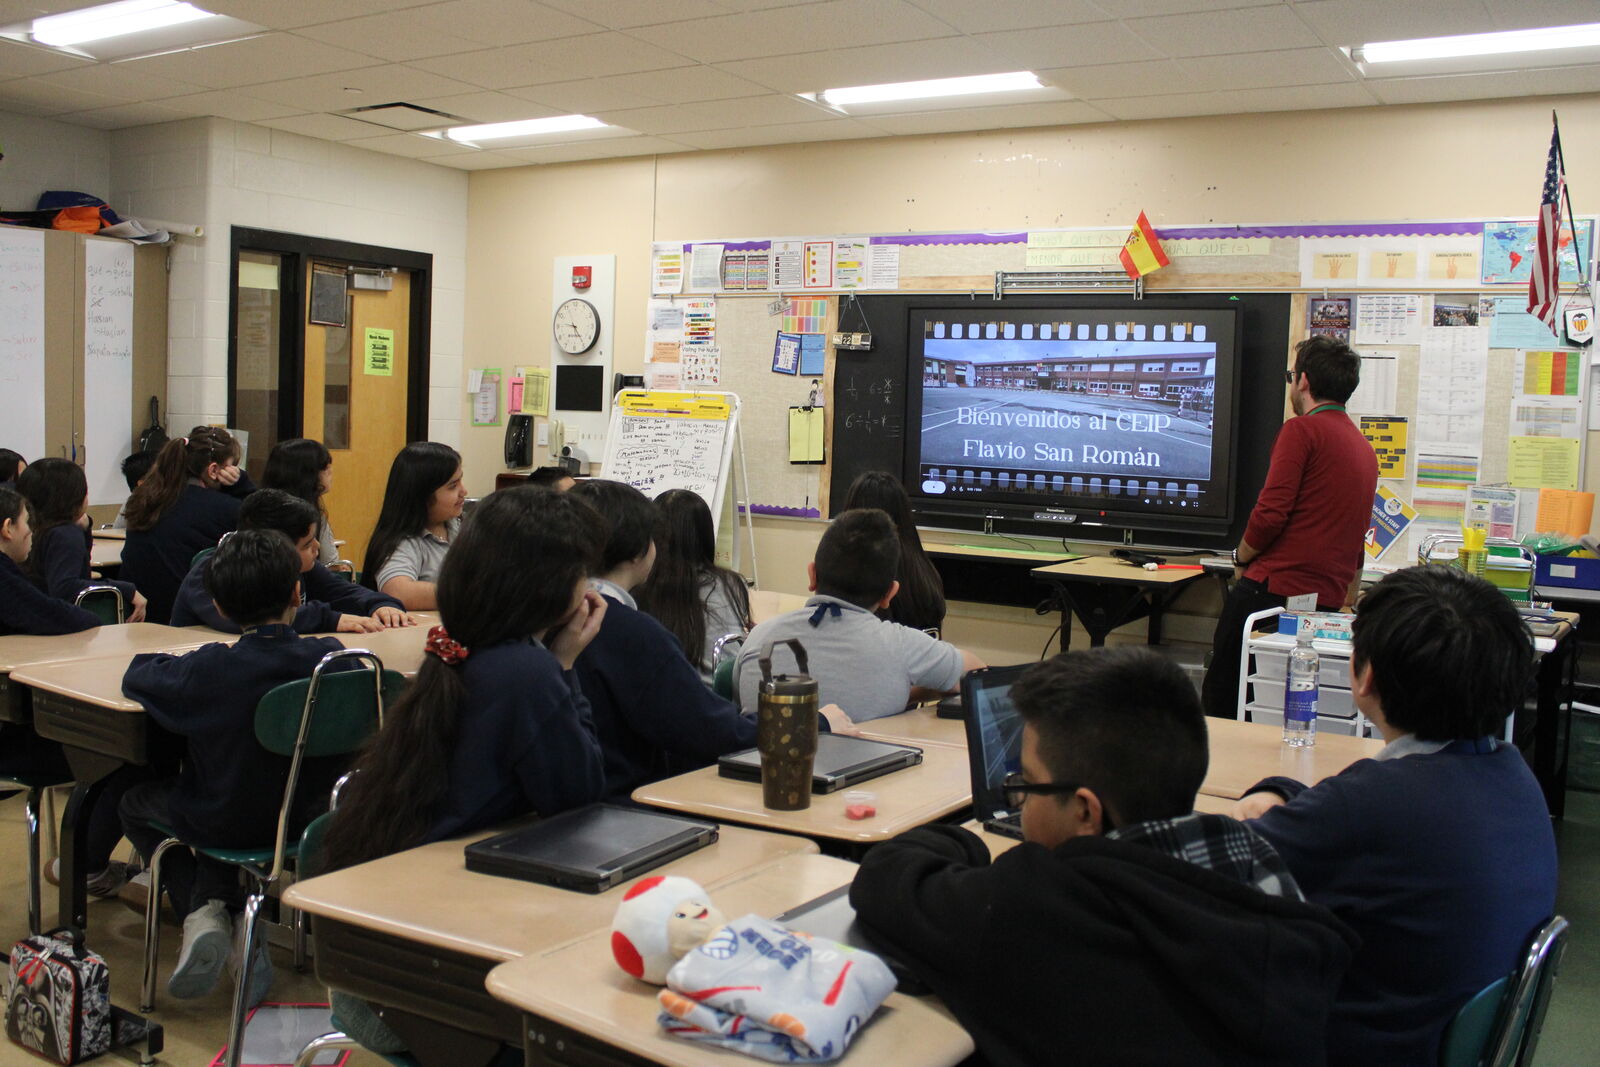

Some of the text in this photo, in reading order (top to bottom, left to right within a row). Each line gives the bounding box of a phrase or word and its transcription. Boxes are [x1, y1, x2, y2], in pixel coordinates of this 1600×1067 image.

[957, 406, 1171, 433] Bienvenidos al CEIP
[963, 439, 1161, 467] Flavio San Román
